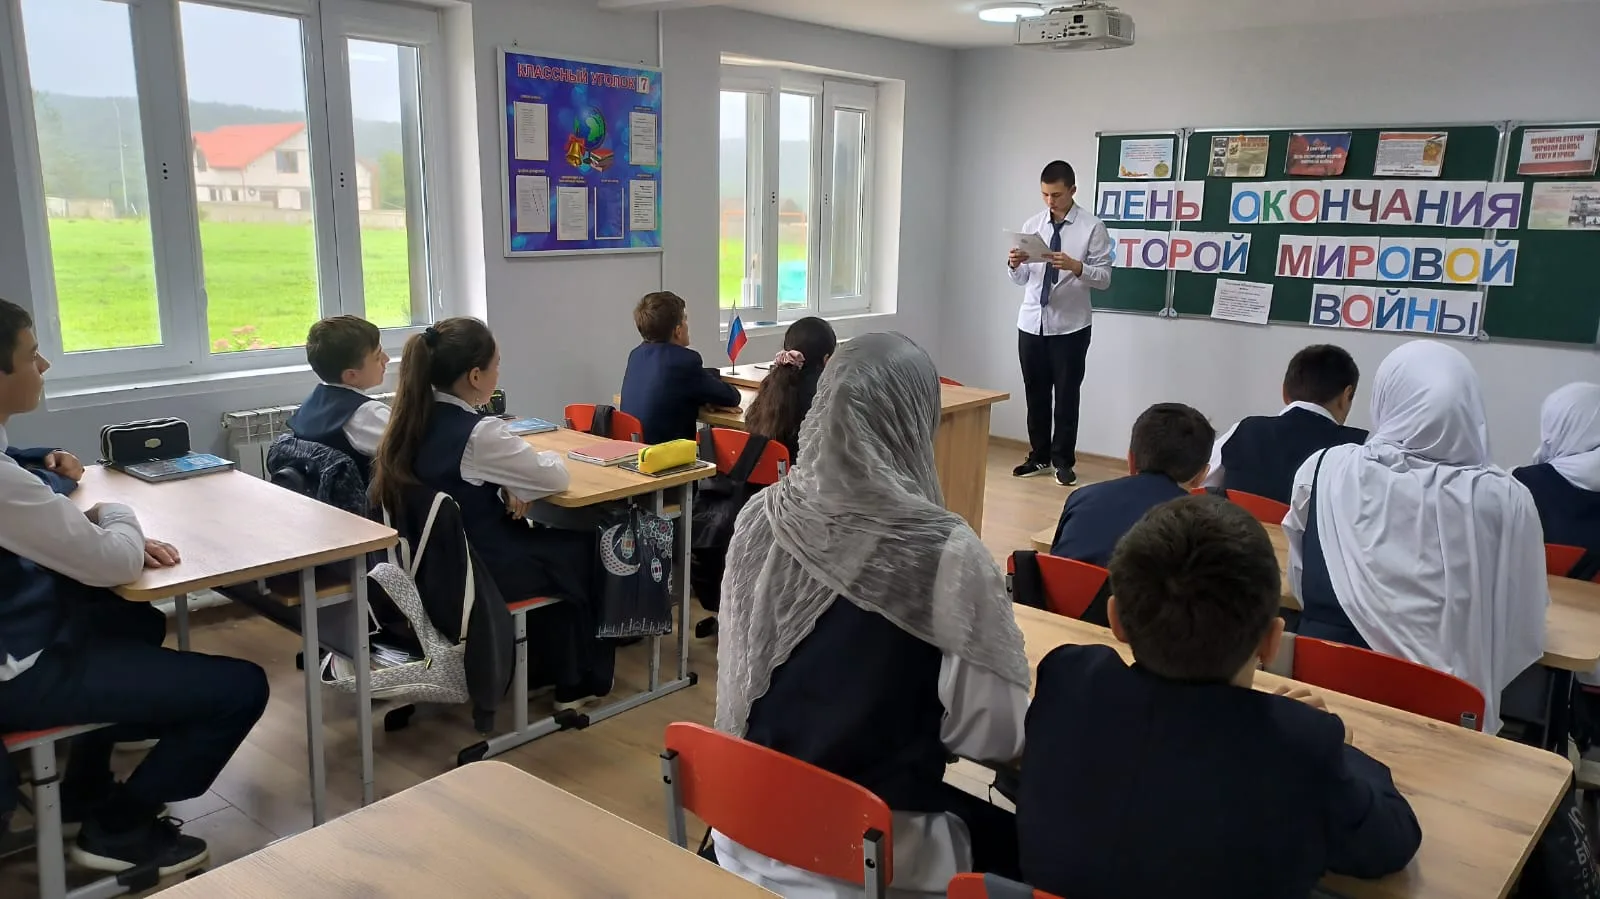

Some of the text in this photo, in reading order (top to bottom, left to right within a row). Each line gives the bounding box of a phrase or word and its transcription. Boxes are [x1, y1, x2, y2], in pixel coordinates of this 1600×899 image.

[517, 62, 648, 91] КЛАССНЫЙ УГОЛОК 7
[1096, 188, 1522, 228] ДЕНЬ ОКОНЧАНИЯ
[1278, 240, 1516, 283] МИРОВОЙ
[1313, 289, 1478, 335] ВОЙНЫ
